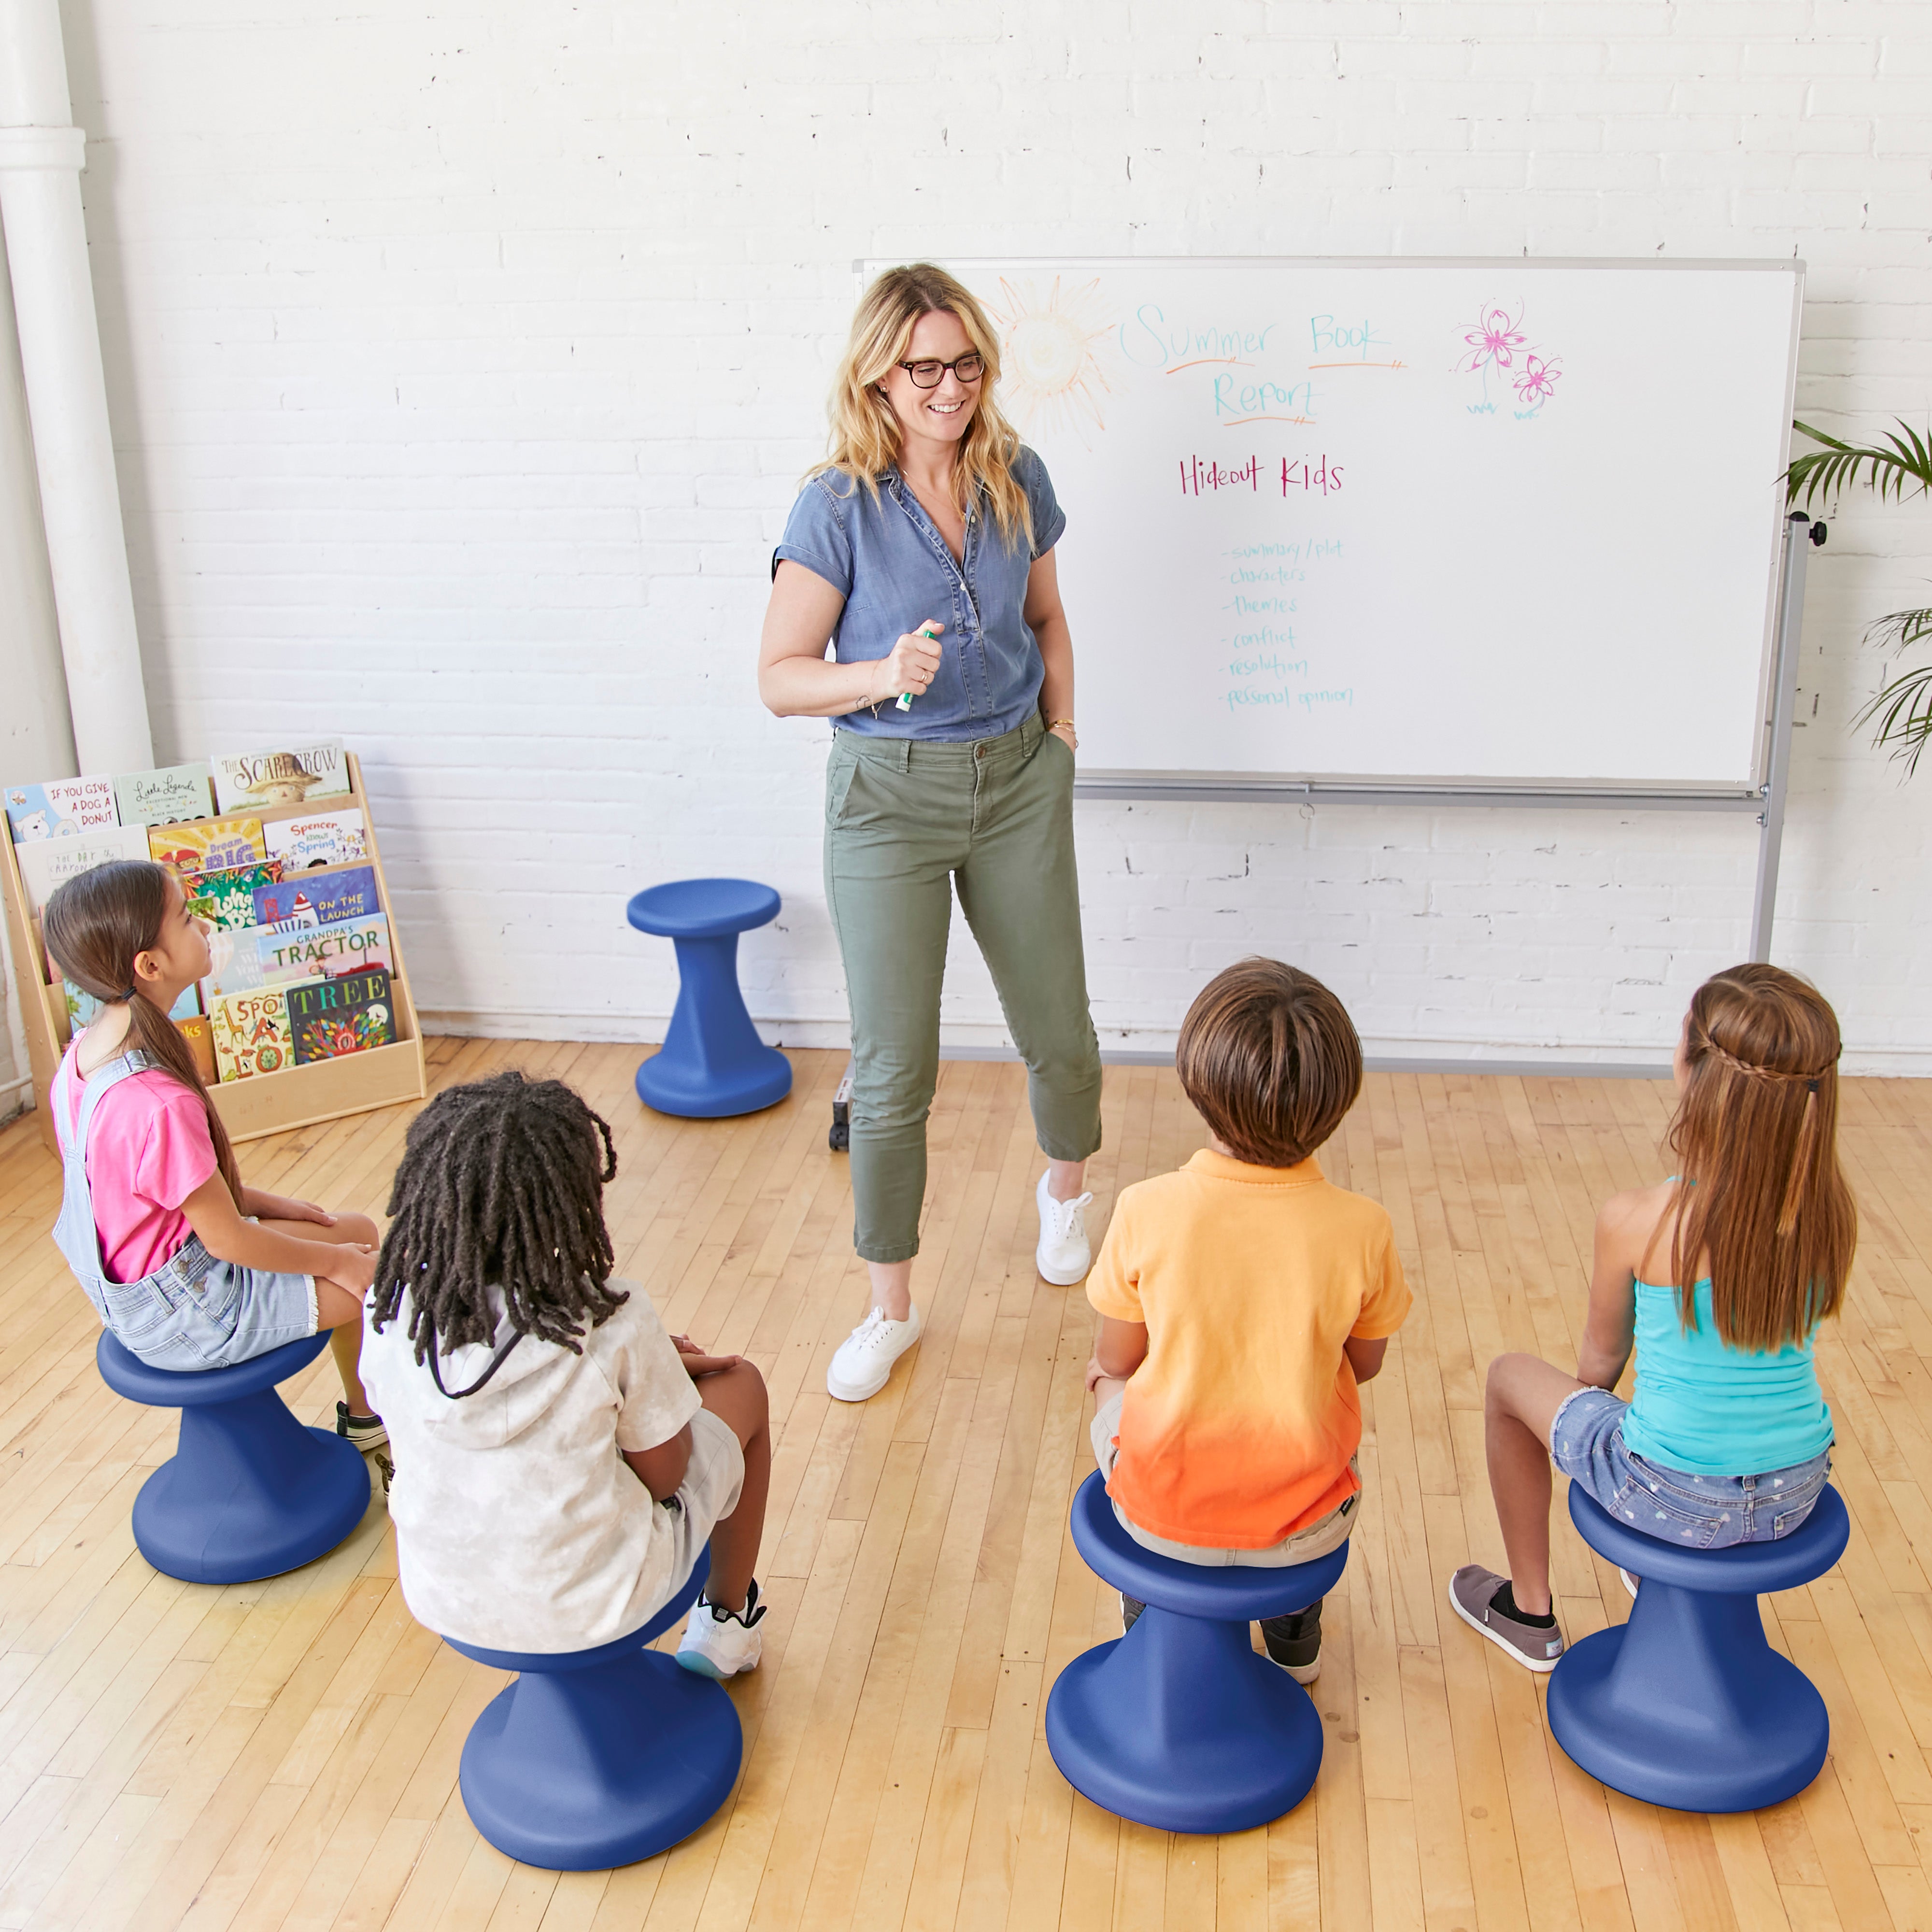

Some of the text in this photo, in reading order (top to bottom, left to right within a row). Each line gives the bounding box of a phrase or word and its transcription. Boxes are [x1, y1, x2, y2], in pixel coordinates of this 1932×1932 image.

[1120, 304, 1392, 368] Summer Book
[1214, 372, 1325, 416] Report
[1180, 454, 1344, 497] Hideout Kids
[1298, 687, 1353, 713] opinion
[221, 759, 239, 774] THE
[51, 783, 109, 800] IF YOU GIVE
[133, 774, 197, 802] Little Legends
[72, 797, 111, 812] A DOG A
[81, 811, 112, 825] DONUT
[291, 822, 338, 836] Spencer
[210, 838, 242, 854] Dream
[297, 838, 336, 854] Spring
[205, 844, 256, 869] BIG
[318, 894, 363, 910] ON THE
[321, 906, 364, 923] LAUNCH
[297, 925, 354, 944] GRANDPA'S
[272, 930, 379, 966] TRACTOR
[294, 975, 386, 1015] TREE
